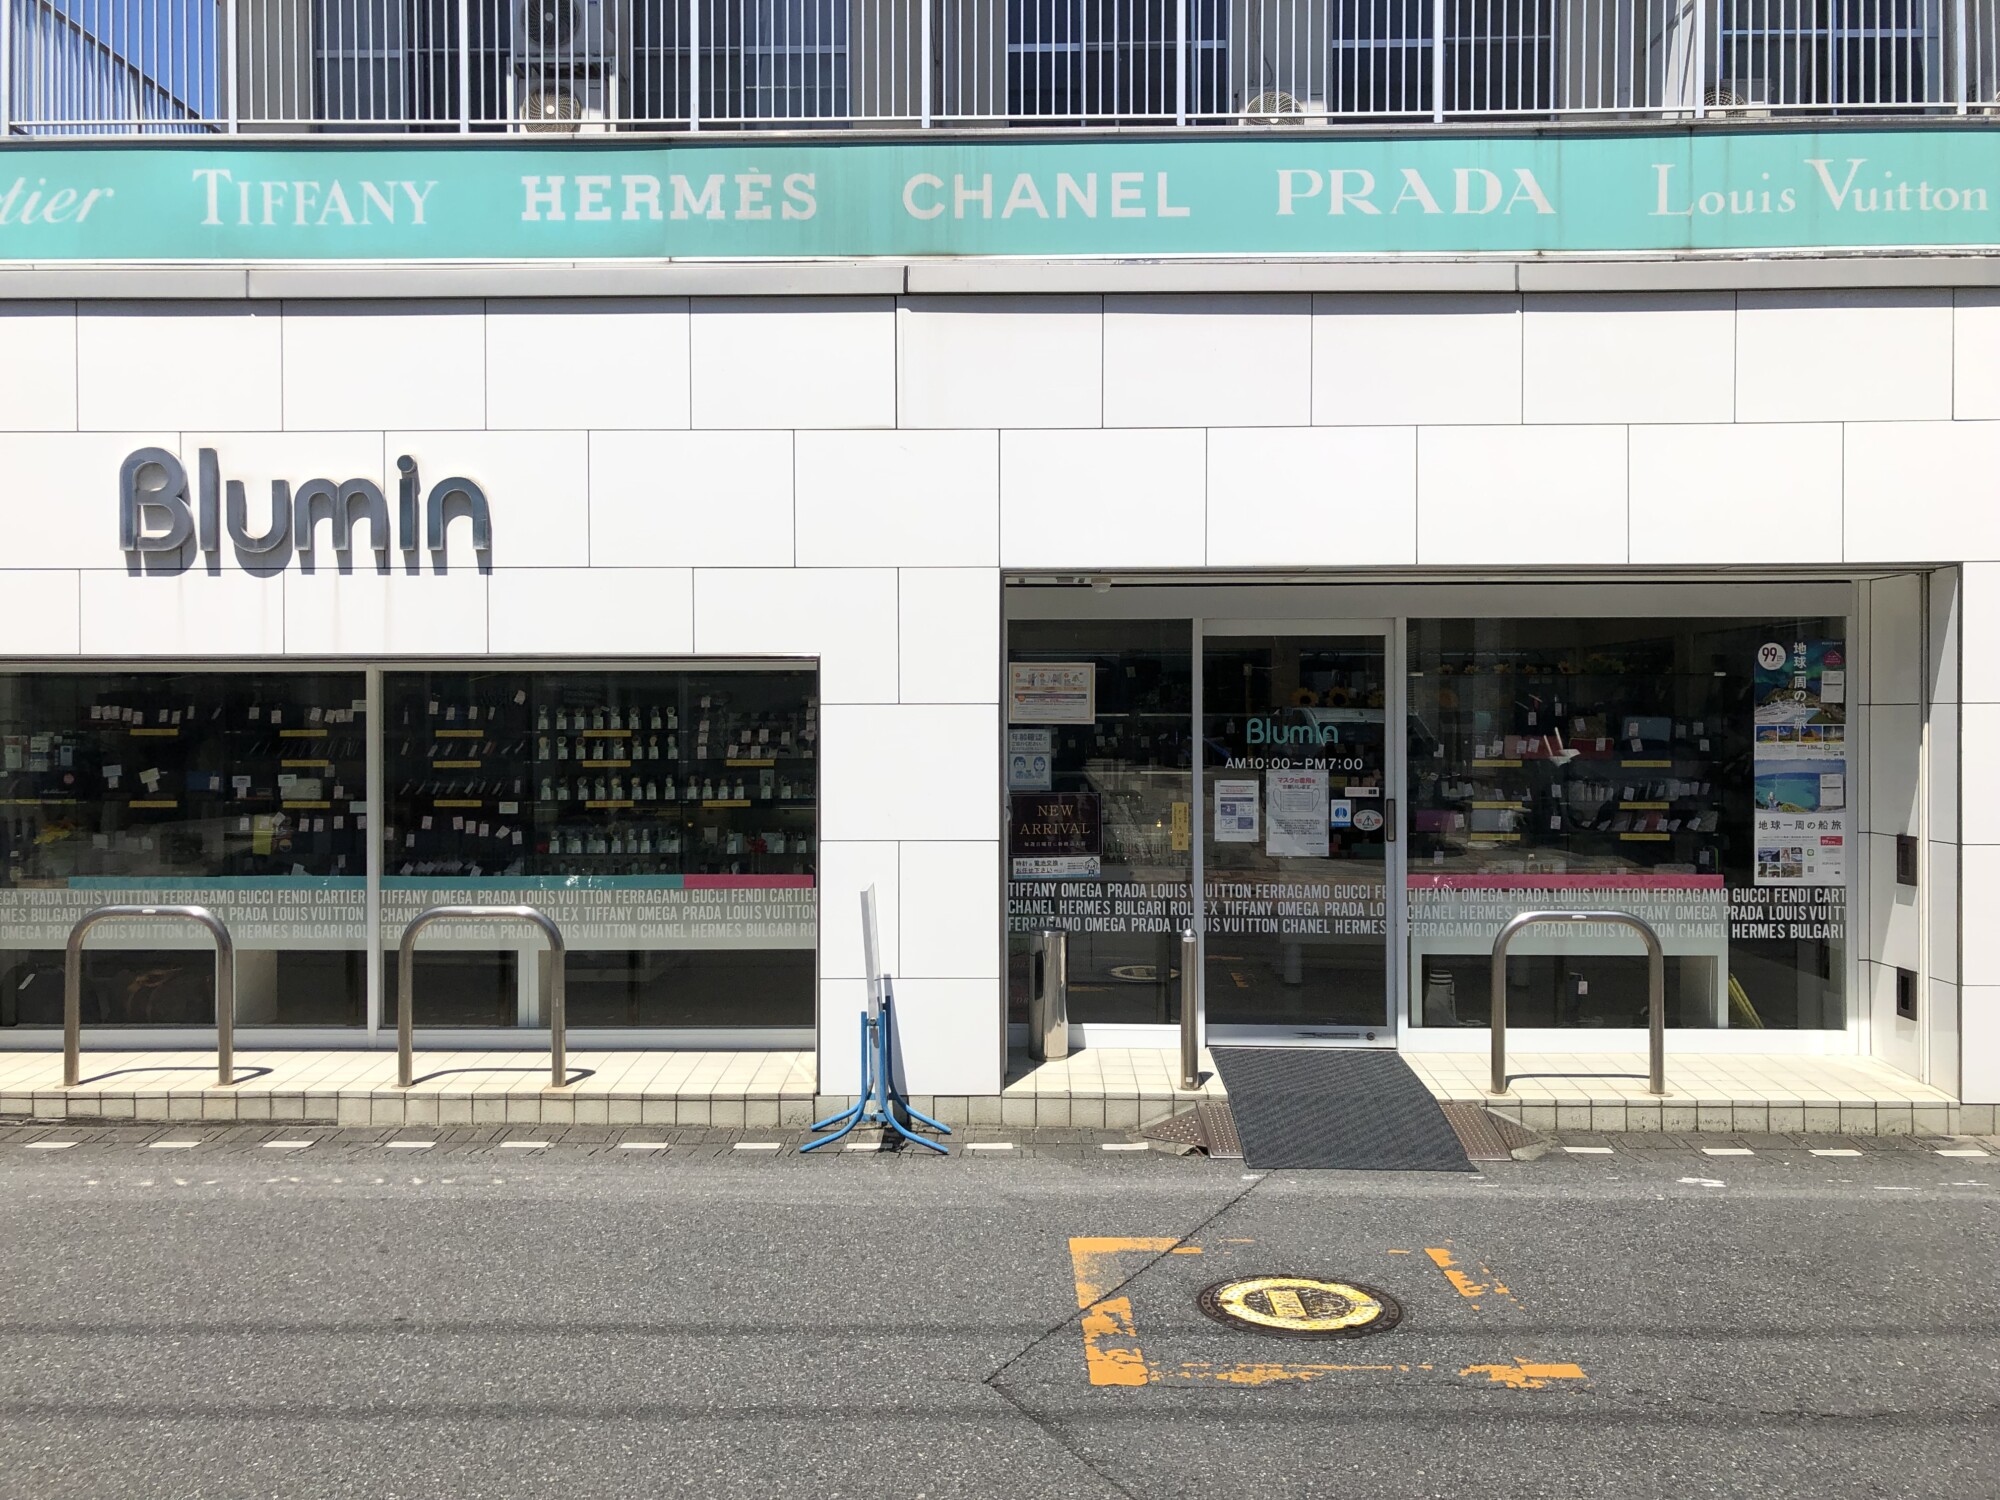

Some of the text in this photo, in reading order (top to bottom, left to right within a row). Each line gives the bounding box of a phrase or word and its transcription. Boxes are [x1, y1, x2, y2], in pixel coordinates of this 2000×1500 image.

[521, 166, 817, 221] HERMÈS
[1276, 167, 1556, 215] PRADA
[1648, 158, 1989, 216] Louis Vuitton
[192, 168, 438, 227] TIFFANY
[902, 171, 1190, 220] CHANEL
[119, 446, 490, 554] Blumin
[1762, 647, 1777, 662] 99
[1246, 717, 1338, 745] Blumin
[1037, 804, 1074, 817] NEW
[1019, 823, 1091, 835] ARRIVAL
[1758, 819, 1842, 831] 地球一周の船旅
[23, 891, 63, 905] PRADA
[66, 890, 102, 904] LOUIS
[103, 890, 159, 904] VUITTON
[163, 890, 235, 904] FERRAGAMO
[238, 890, 273, 904] GUCCI
[277, 890, 312, 904] FENDI
[315, 890, 365, 904] CARTIER
[380, 889, 428, 904] TIFFANY
[431, 889, 472, 904] OMEGA
[477, 889, 516, 904] PRADA
[520, 889, 555, 904] LOUIS
[558, 889, 611, 904] VUITTON
[692, 889, 727, 904] GUCCI
[732, 889, 765, 904] FENDI
[1008, 883, 1057, 898] TIFFANY
[1061, 883, 1102, 898] OMEGA
[1107, 883, 1147, 898] PRADA
[1256, 883, 1330, 899] FERRAGAMO
[1334, 883, 1370, 899] GUCCI
[1407, 888, 1456, 902] TIFFANY
[1461, 888, 1504, 902] OMEGA
[1509, 888, 1549, 902] PRADA
[1553, 888, 1590, 902] LOUIS
[1592, 888, 1648, 902] VUITTON
[1653, 888, 1728, 903] FERRAGAMO
[1732, 888, 1770, 903] GUCCI
[1774, 888, 1811, 903] FENDI
[31, 907, 81, 922] BULGARI
[229, 907, 268, 921] PRADA
[273, 907, 308, 921] LOUIS
[310, 907, 364, 921] VUITTON
[584, 906, 632, 921] TIFFANY
[637, 906, 677, 921] OMEGA
[682, 906, 722, 921] PRADA
[726, 905, 762, 919] LOUIS
[1008, 900, 1054, 915] CHANEL
[1059, 900, 1110, 915] HERMES
[1115, 900, 1165, 915] BULGARI
[1223, 901, 1273, 916] TIFFANY
[1277, 901, 1319, 916] OMEGA
[1324, 901, 1365, 916] PRADA
[1407, 905, 1455, 920] CHANEL
[1459, 905, 1512, 920] HERMES
[1675, 905, 1717, 920] OMEGA
[1723, 905, 1764, 920] PRADA
[1769, 905, 1807, 920] LOUIS
[1, 925, 41, 939] OMEGA
[91, 925, 127, 939] LOUIS
[128, 925, 183, 939] VUITTON
[238, 925, 288, 939] HERMES
[292, 925, 342, 939] BULGARI
[455, 924, 496, 939] OMEGA
[500, 924, 539, 939] PRADA
[582, 924, 636, 939] VUITTON
[640, 924, 687, 939] CHANEL
[691, 923, 742, 937] HERMES
[746, 923, 796, 937] BULGARI
[1084, 917, 1126, 932] OMEGA
[1131, 917, 1171, 932] PRADA
[1222, 918, 1278, 933] VUITTON
[1282, 918, 1330, 933] CHANEL
[1335, 919, 1386, 934] HERMES
[1407, 923, 1481, 937] FERRAGAMO
[1533, 923, 1573, 937] PRADA
[1579, 923, 1615, 937] LOUIS
[1679, 923, 1728, 938] CHANEL
[1732, 923, 1785, 938] HERMES
[1790, 923, 1843, 938] BULGARI
